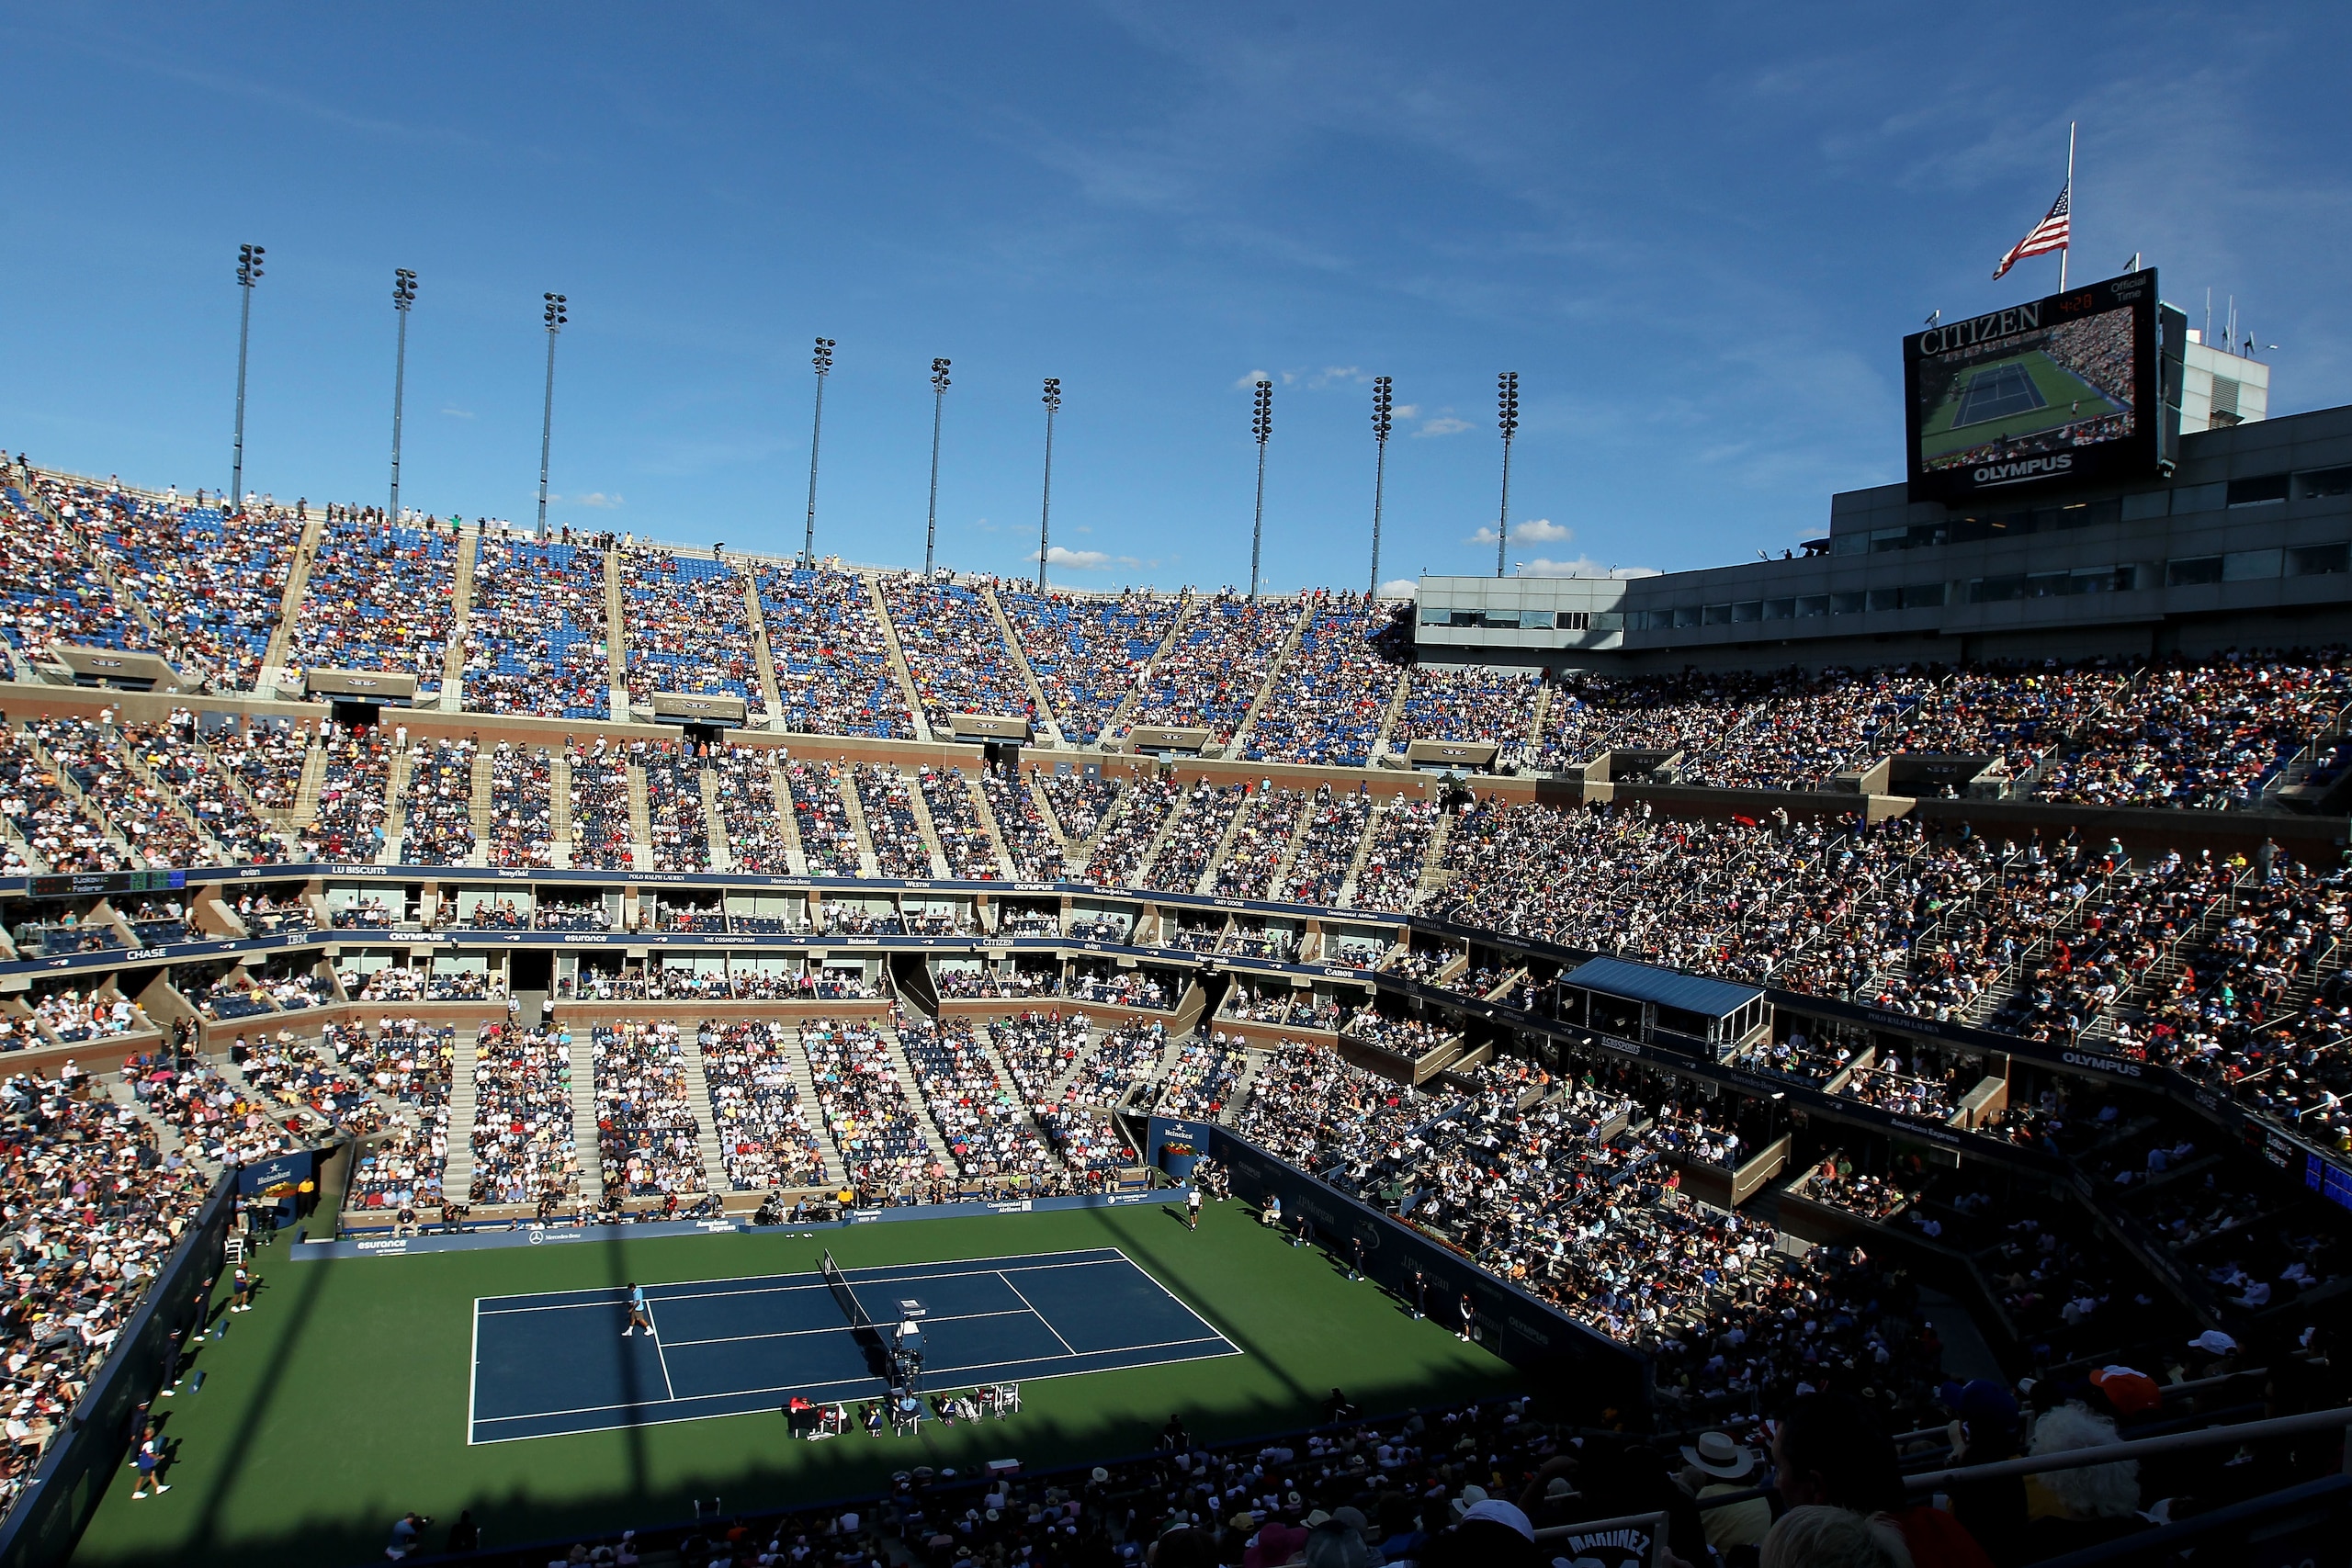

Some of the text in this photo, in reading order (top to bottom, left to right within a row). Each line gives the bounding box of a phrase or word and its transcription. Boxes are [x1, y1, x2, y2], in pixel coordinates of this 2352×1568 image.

[2110, 275, 2146, 294] Official
[2116, 288, 2142, 302] Time
[2059, 294, 2093, 313] 4:28
[1919, 300, 2042, 355] CITIZEN
[1973, 453, 2072, 482] OLYMPUS
[241, 868, 260, 876] evian
[332, 866, 387, 874] LU BISCUITS
[498, 869, 529, 878] Stonyfield
[73, 885, 104, 893] Federer
[1227, 899, 1244, 908] GOOSE
[287, 934, 308, 944] IBM
[389, 933, 445, 942] OLYMPUS
[982, 939, 1014, 947] CITIZEN
[126, 948, 166, 960] CHASE
[1324, 968, 1354, 978] Canon
[1911, 1021, 1940, 1033] LAUREN
[2062, 1051, 2143, 1077] OLYMPUS
[1730, 1072, 1777, 1093] Mercedes-Benz
[1165, 1129, 1193, 1140] Heineken
[1890, 1117, 1961, 1145] American Express
[257, 1169, 290, 1186] Heineken
[695, 1219, 729, 1228] American
[708, 1224, 736, 1233] Express
[357, 1240, 406, 1250] esurance
[1508, 1315, 1549, 1345] OLYMPUS
